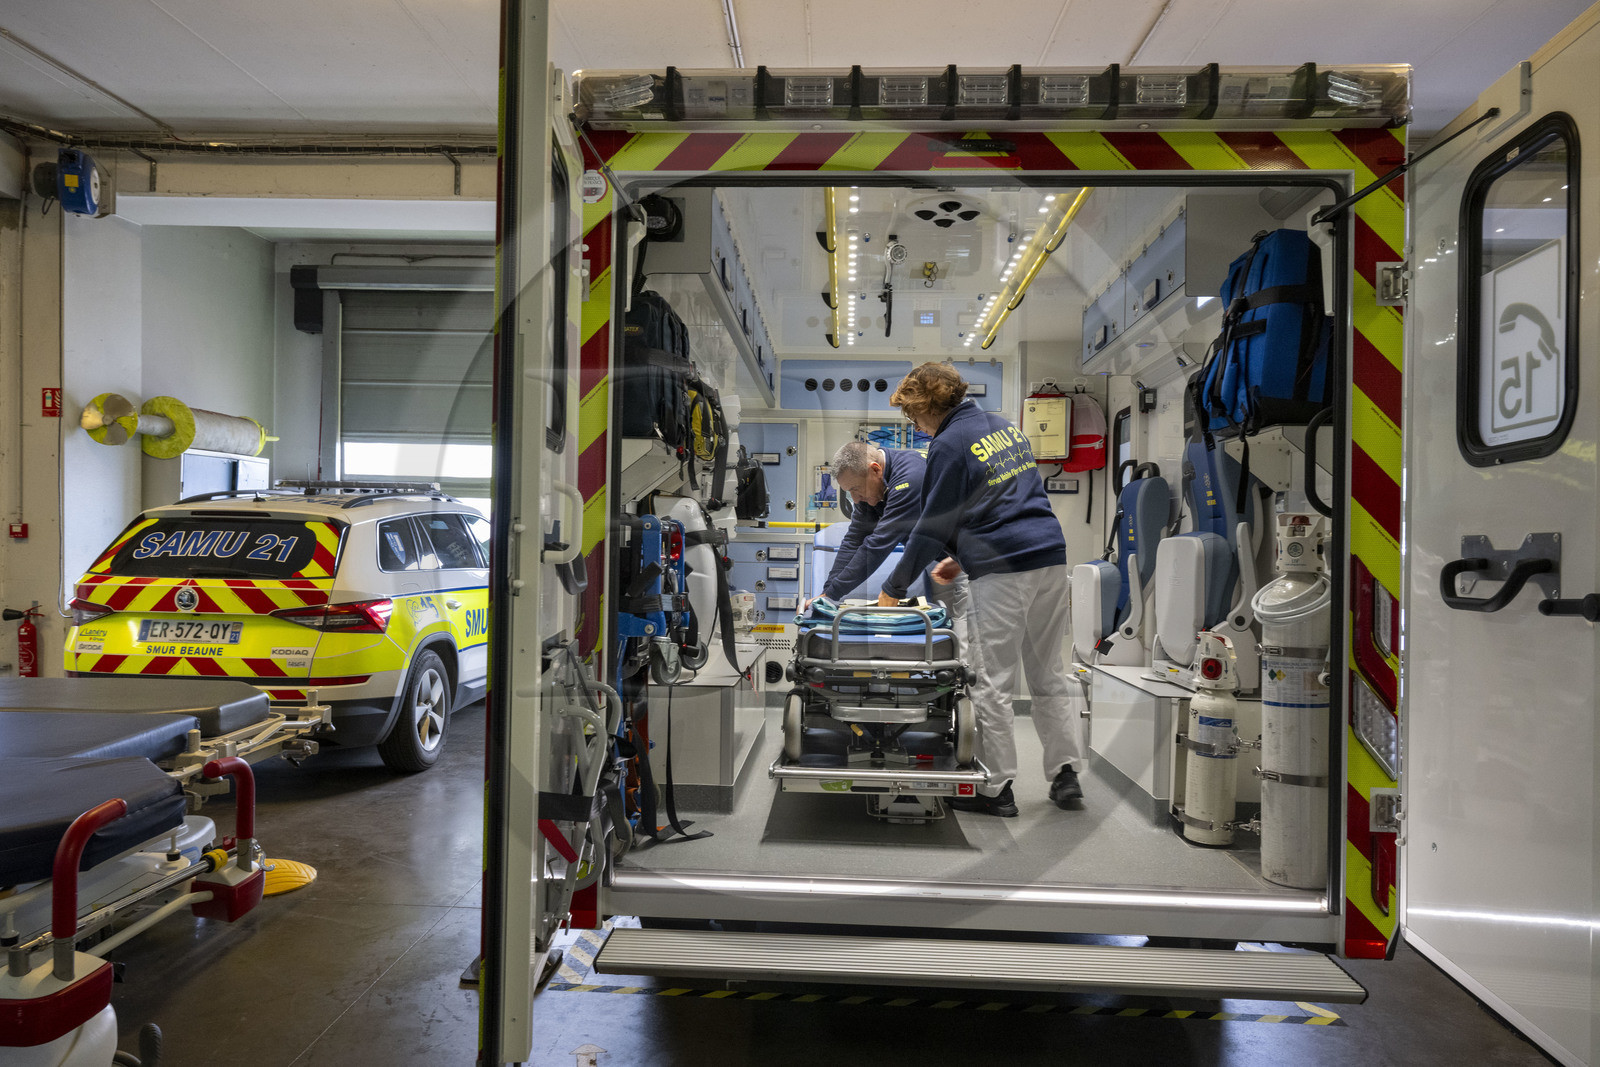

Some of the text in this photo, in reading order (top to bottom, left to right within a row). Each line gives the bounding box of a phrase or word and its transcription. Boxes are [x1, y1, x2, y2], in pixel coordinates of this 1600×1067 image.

[970, 429, 1013, 462] SAMU
[133, 531, 299, 562] SAMU 21
[420, 597, 439, 618] 15
[150, 621, 231, 640] ER-572-QY
[465, 608, 489, 637] SMU
[231, 633, 239, 641] 21
[146, 645, 224, 656] SMUR BEAUNE
